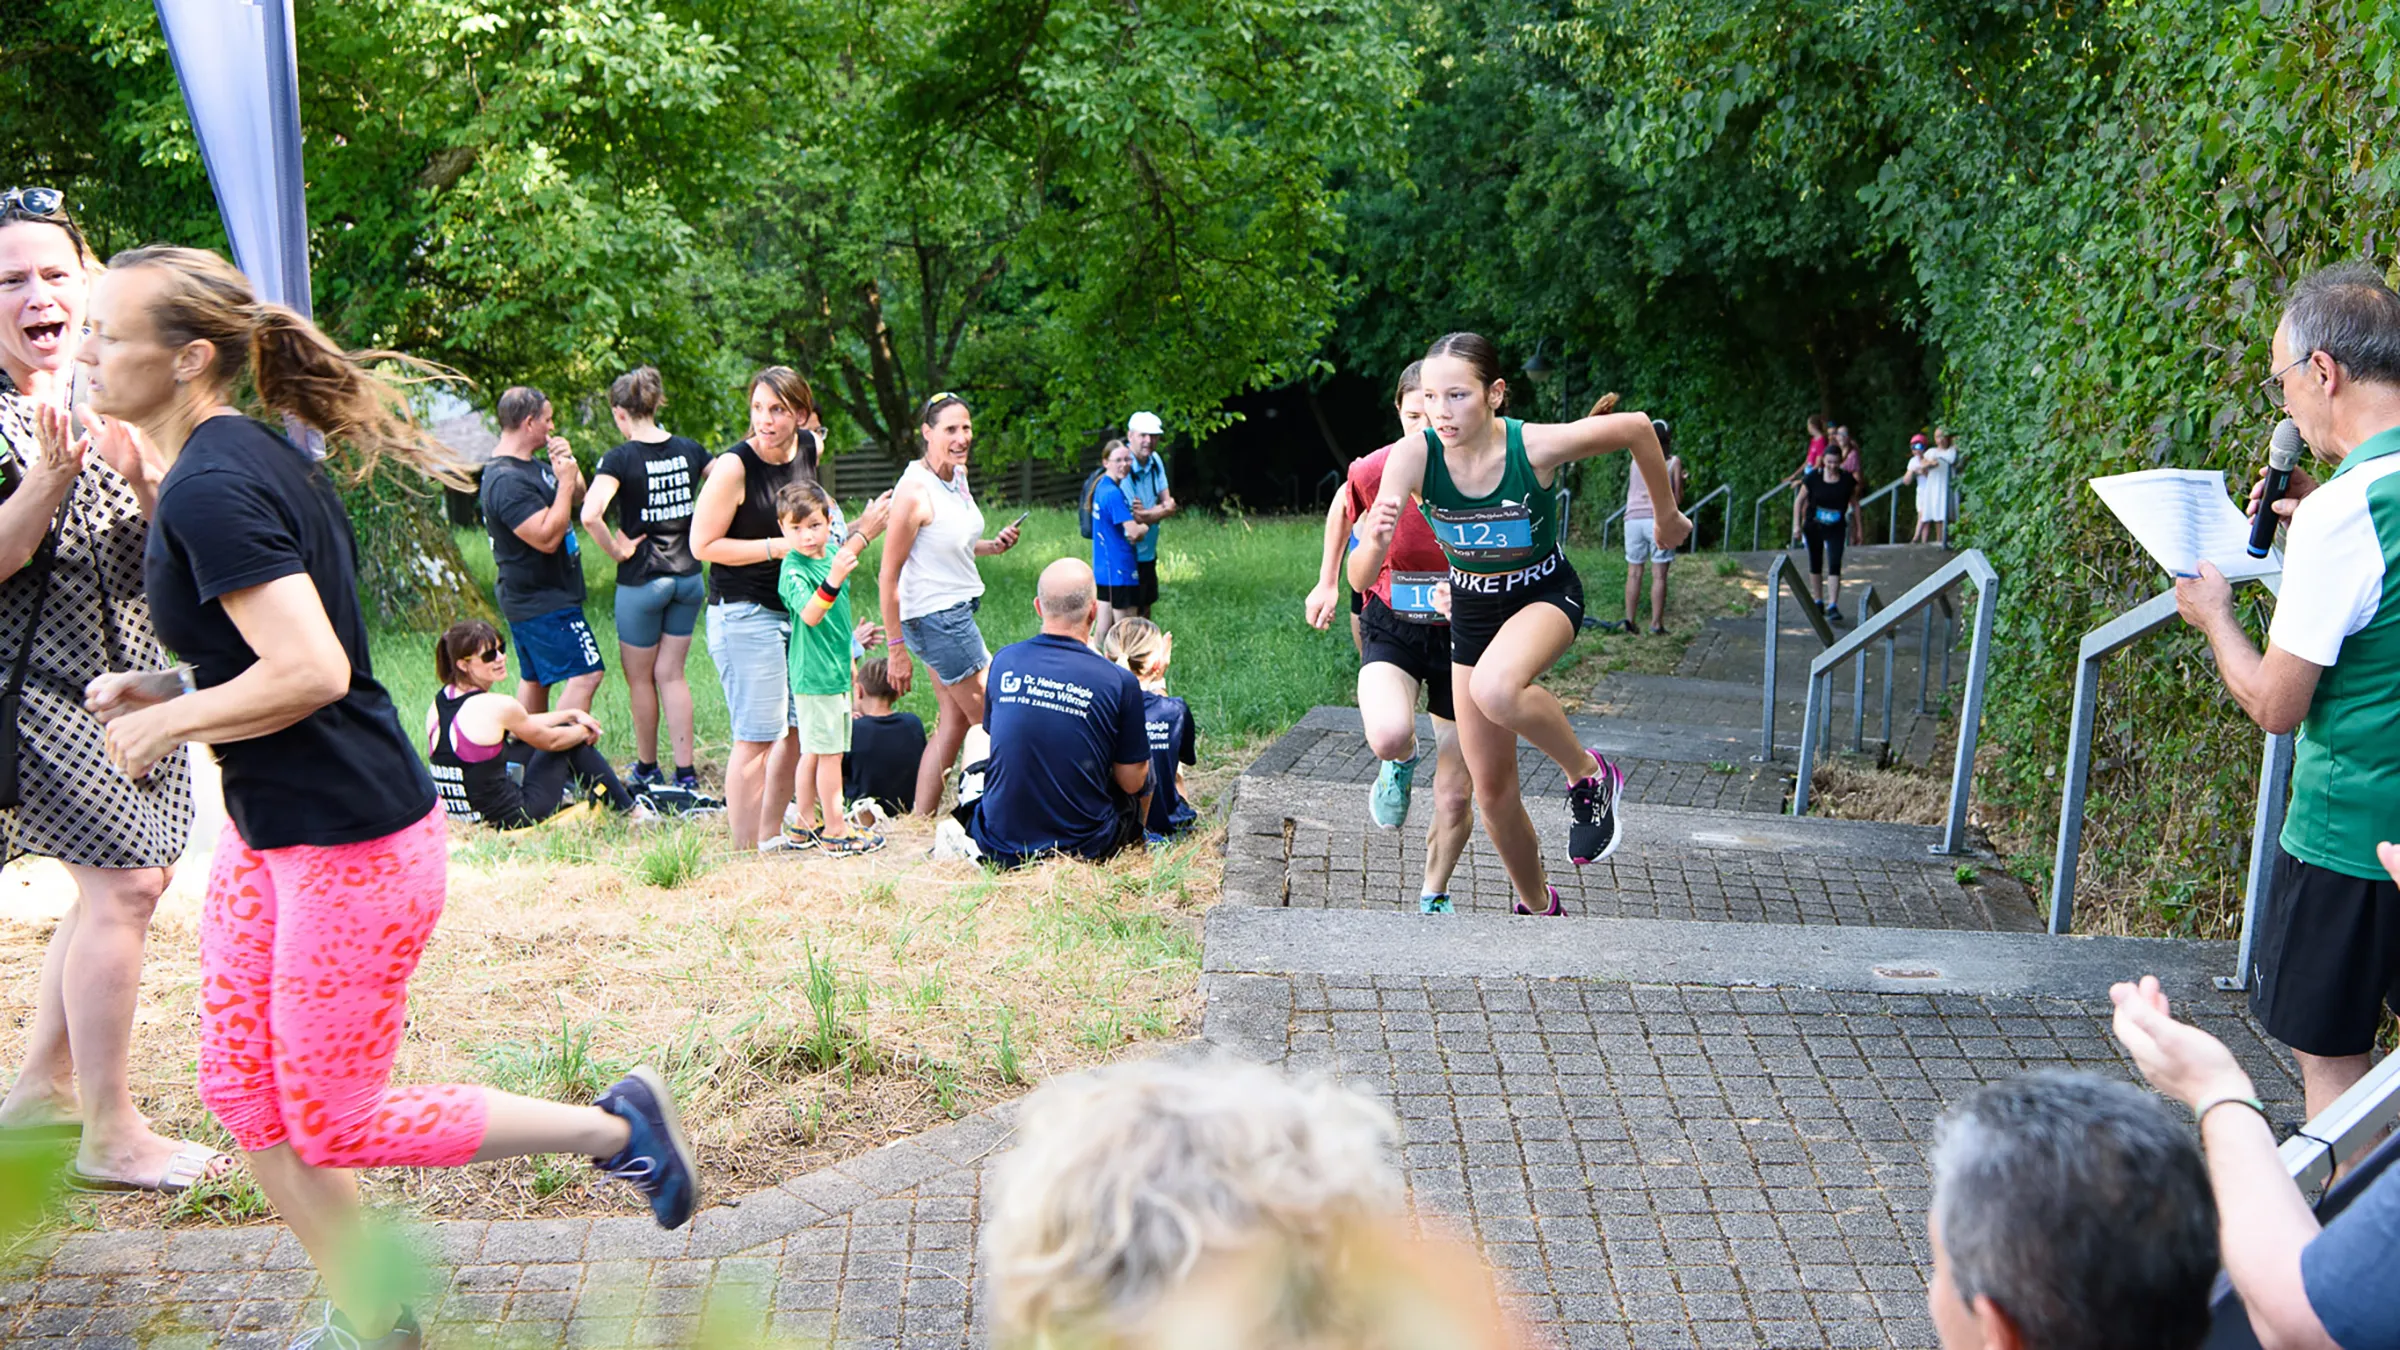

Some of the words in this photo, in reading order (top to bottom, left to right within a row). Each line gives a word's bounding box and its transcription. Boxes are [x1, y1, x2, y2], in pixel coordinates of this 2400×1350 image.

[645, 455, 688, 475] HARDER
[648, 471, 690, 491] BETTER
[648, 487, 691, 506] FASTER
[1449, 565, 1500, 593] NIKE
[1505, 553, 1556, 592] PRO
[1023, 674, 1036, 685] Dr.
[1037, 677, 1065, 691] Heiner
[1066, 682, 1094, 699] Geigle
[1026, 685, 1055, 699] Marco
[1057, 690, 1091, 708] Wörner
[433, 781, 467, 798] ETTER
